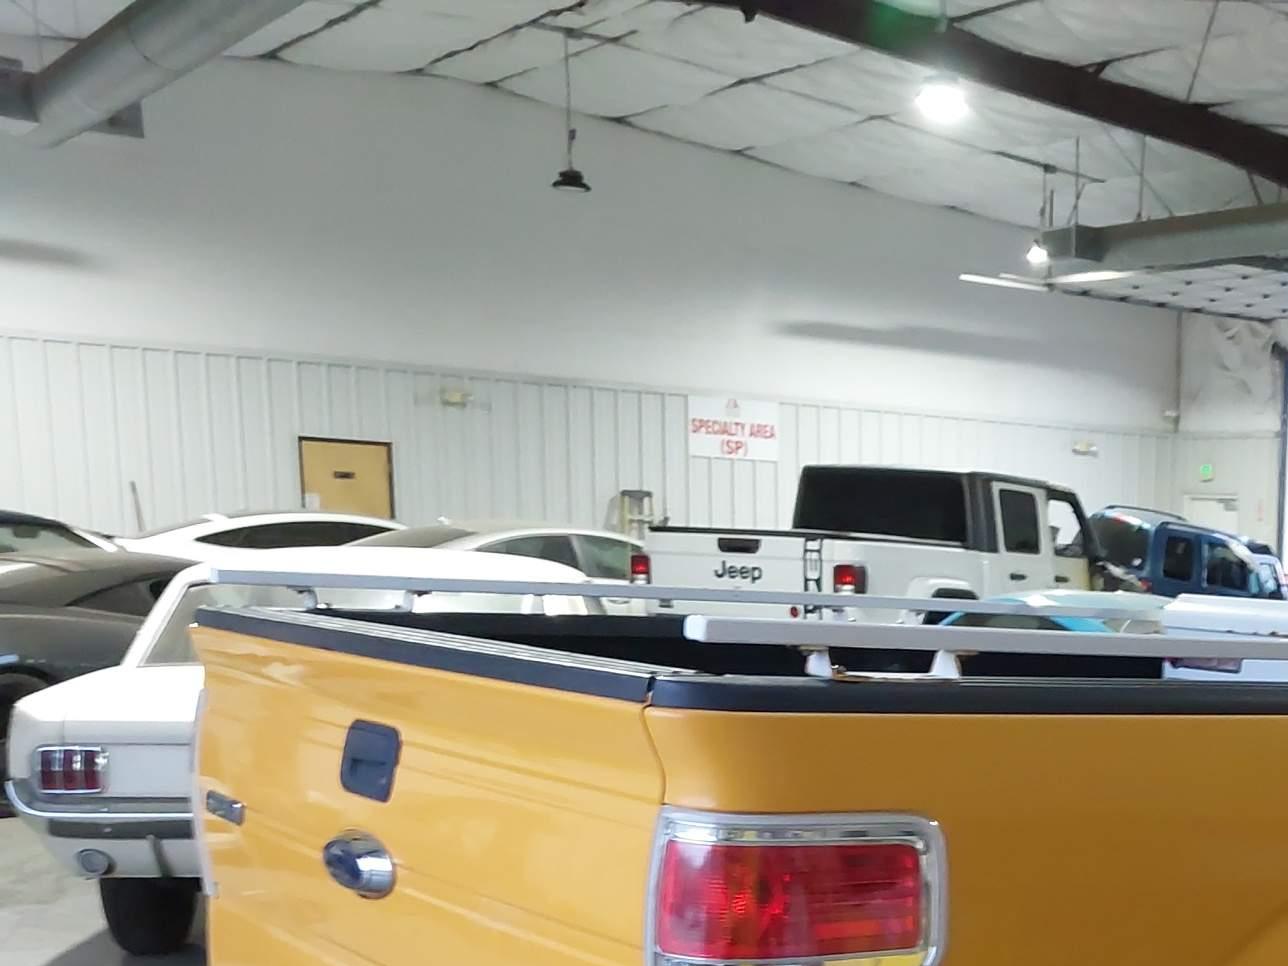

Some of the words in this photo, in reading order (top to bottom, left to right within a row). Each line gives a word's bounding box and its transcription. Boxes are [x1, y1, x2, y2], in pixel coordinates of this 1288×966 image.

[691, 418, 745, 437] SPECIALTY
[750, 423, 776, 440] AREA
[721, 439, 748, 457] (SP)
[714, 560, 762, 584] Jeep
